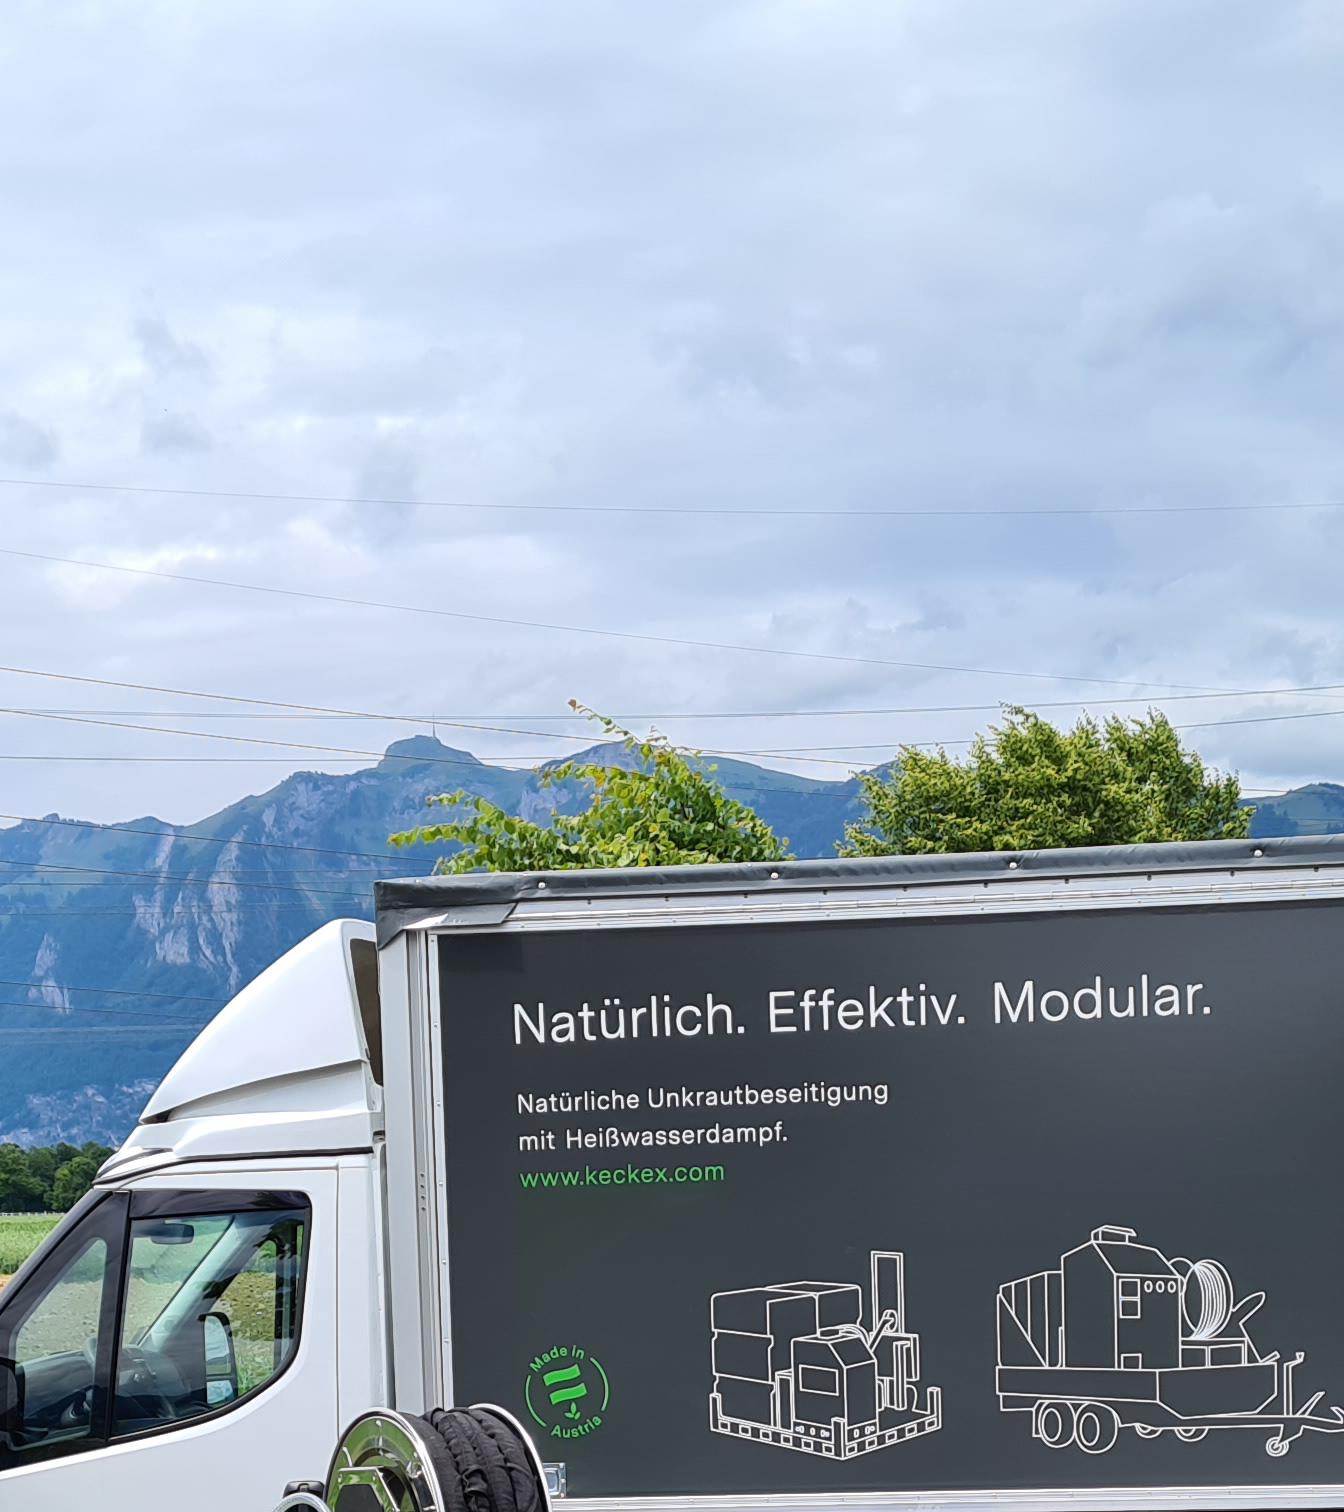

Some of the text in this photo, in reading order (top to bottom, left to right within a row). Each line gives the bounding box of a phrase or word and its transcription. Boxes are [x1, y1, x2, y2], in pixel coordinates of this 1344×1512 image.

[513, 974, 1211, 1045] Natürlich. Effektiv. Modular.
[517, 1081, 888, 1114] Natürliche Unkrautbeseitigung
[519, 1121, 788, 1151] mit Heißwasserdampf.
[520, 1164, 725, 1188] www.keckex.com
[529, 1344, 585, 1372] Made in
[550, 1416, 602, 1438] Austria
